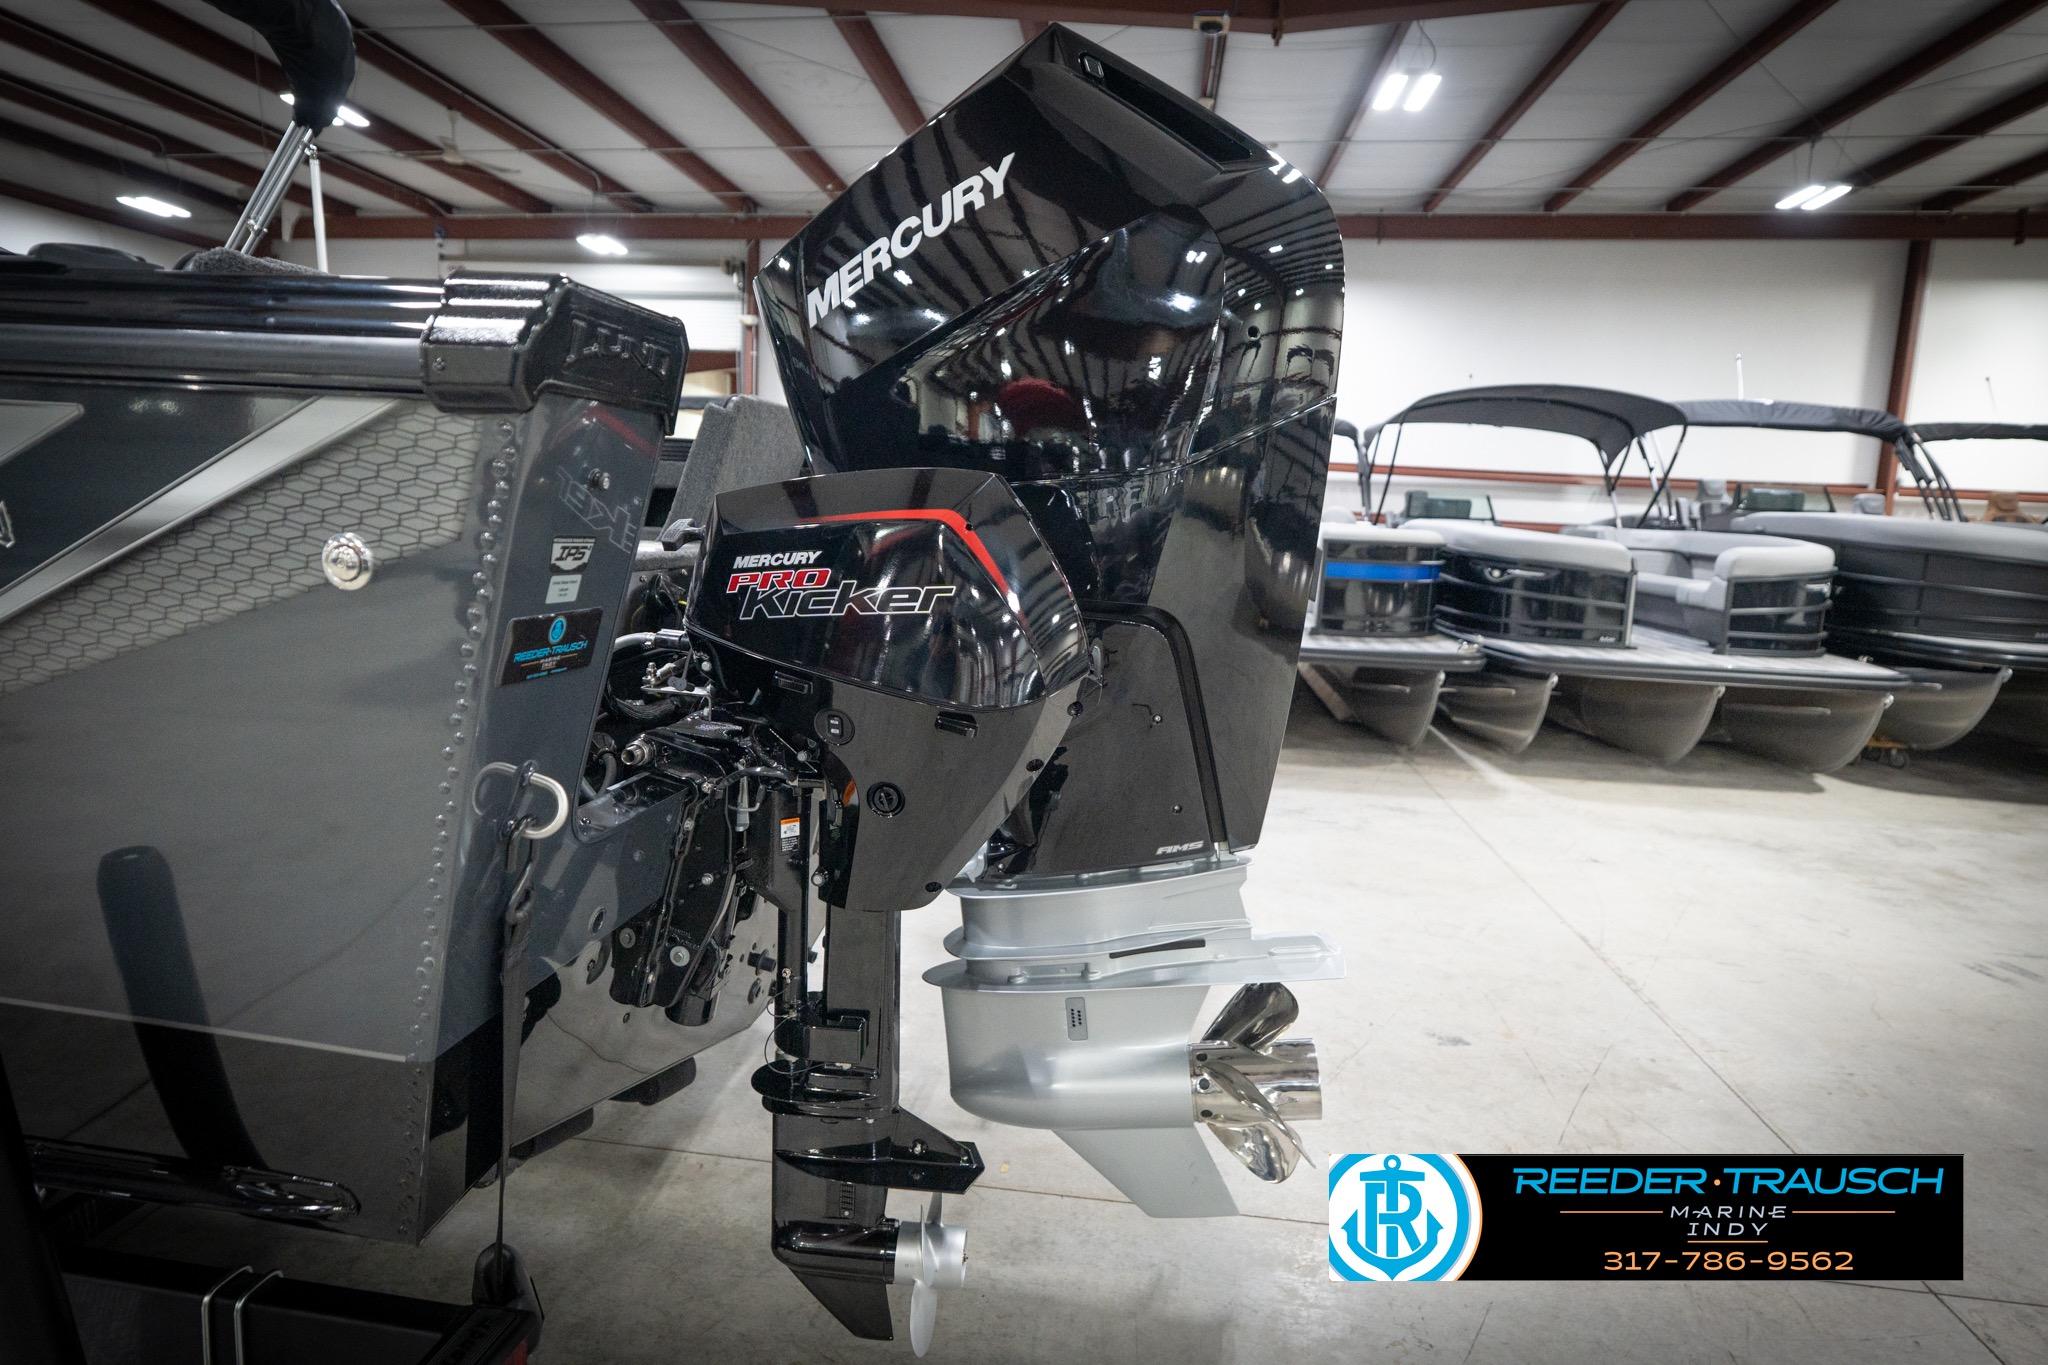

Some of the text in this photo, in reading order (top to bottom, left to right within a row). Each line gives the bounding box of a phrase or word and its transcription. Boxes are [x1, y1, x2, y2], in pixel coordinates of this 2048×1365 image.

[807, 152, 1015, 329] MERCURY
[733, 550, 823, 569] MERCURY
[726, 568, 831, 594] PRO
[1155, 840, 1204, 856] AMS
